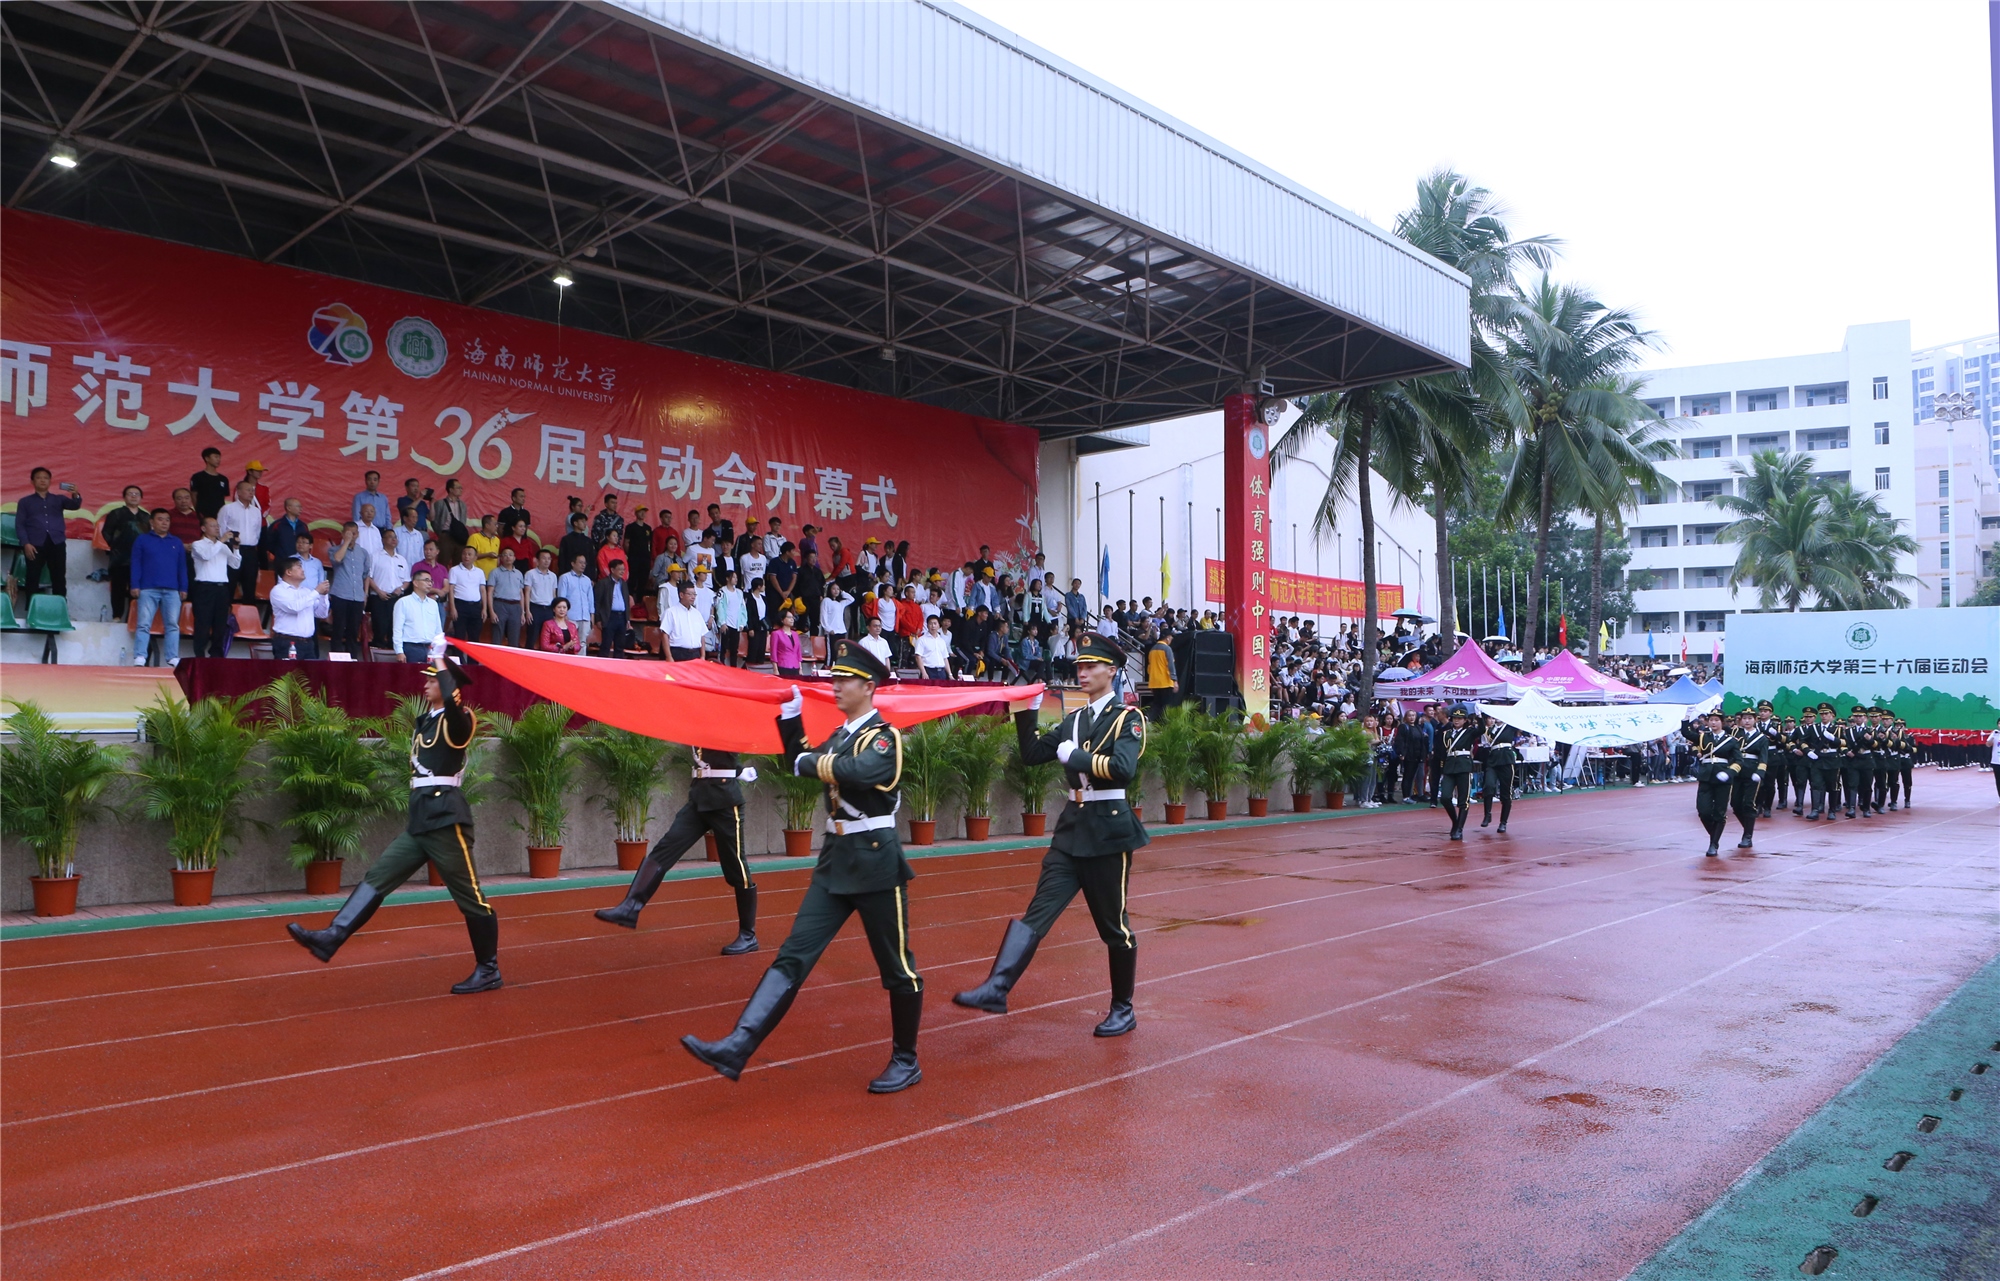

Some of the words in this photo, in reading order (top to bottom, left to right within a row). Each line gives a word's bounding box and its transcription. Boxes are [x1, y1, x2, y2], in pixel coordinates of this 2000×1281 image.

[463, 338, 617, 391] 海南师范大学
[463, 369, 507, 384] HAINAN
[510, 377, 554, 393] NORMAL
[558, 386, 615, 404] UNIVERSITY
[1249, 474, 1267, 692] 体育强则中国强
[1745, 657, 1989, 675] 海南师范大学第三十六届运动会
[1400, 687, 1435, 696] 我的未来
[1442, 687, 1478, 696] 不可限量
